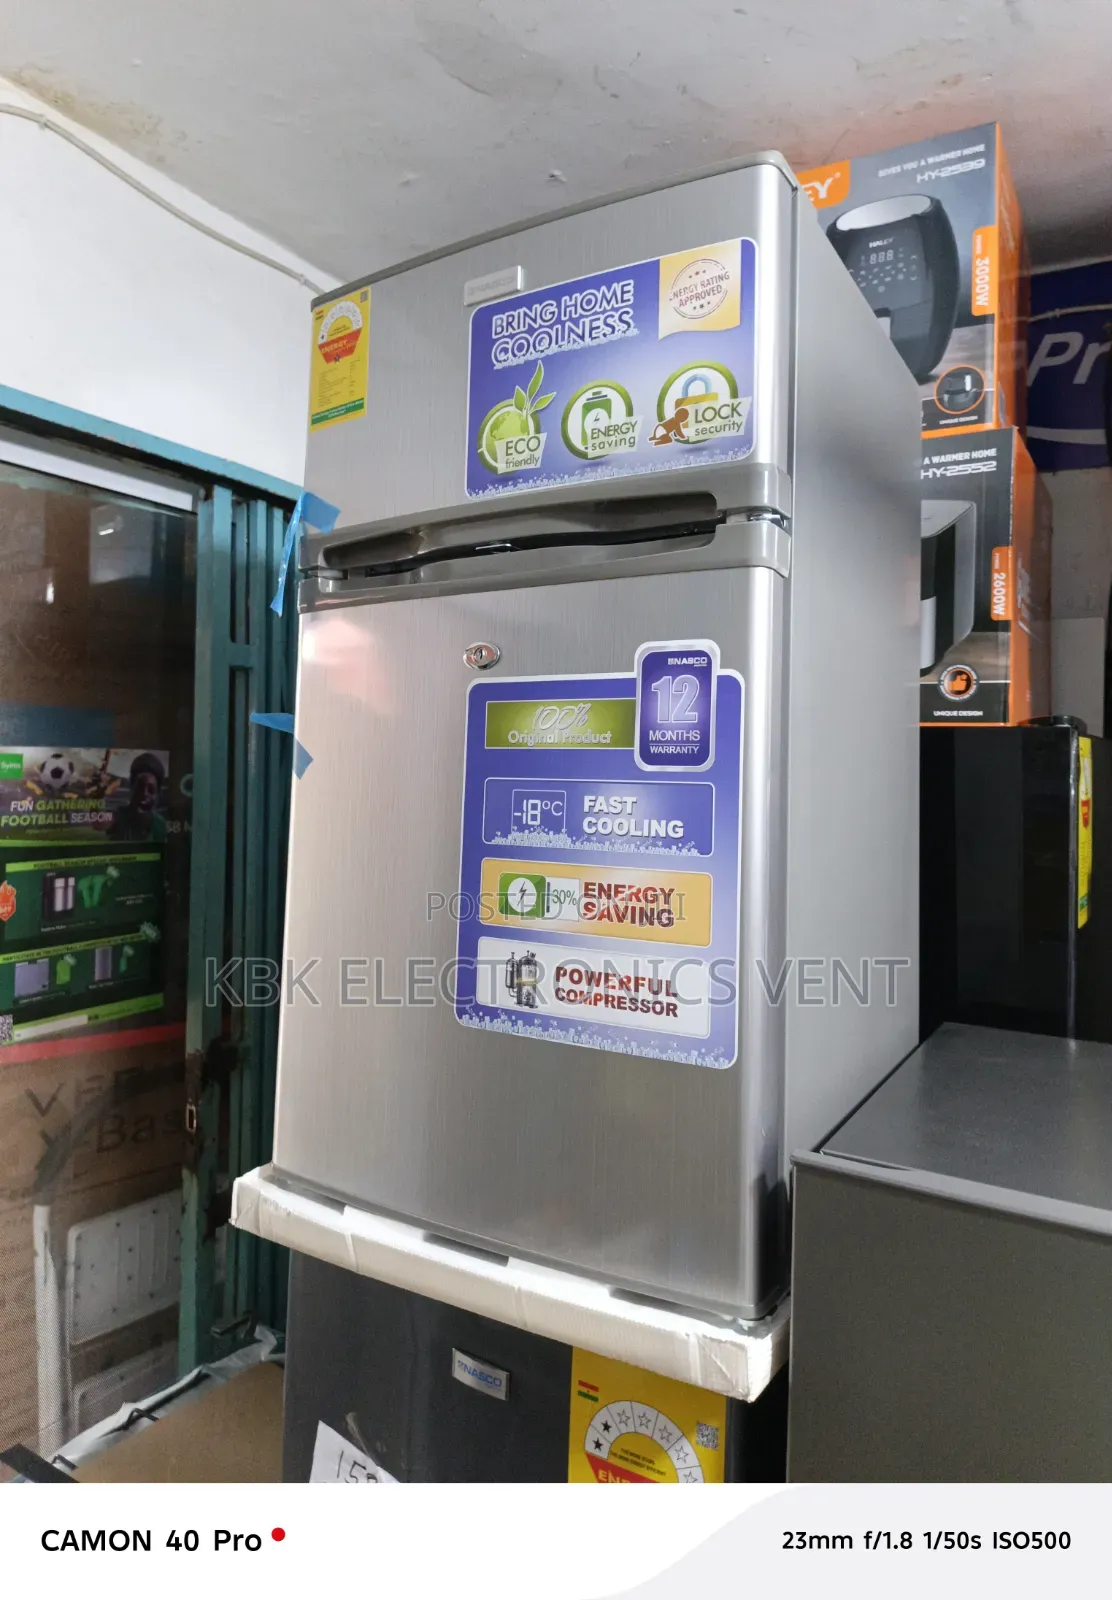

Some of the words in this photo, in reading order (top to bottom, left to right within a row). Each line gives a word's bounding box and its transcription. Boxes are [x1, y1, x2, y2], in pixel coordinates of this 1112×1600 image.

[962, 144, 985, 156] HOME
[700, 271, 730, 289] RATING
[975, 257, 990, 306] 3000W
[679, 285, 723, 308] APPROVED
[492, 301, 558, 338] BRING
[561, 280, 634, 320] HOME
[491, 308, 634, 364] COOLNESS
[694, 401, 743, 424] LOCK
[590, 421, 638, 440] ENERGY
[695, 420, 743, 436] security
[505, 436, 541, 456] ECO
[591, 436, 636, 451] saving
[505, 454, 541, 469] friendly
[923, 456, 930, 465] A
[931, 452, 970, 464] WARMER
[971, 448, 997, 459] HOME
[920, 461, 997, 479] HY-2552
[993, 572, 1006, 616] 2600W
[651, 675, 700, 723] 12
[533, 703, 592, 731] 100%
[508, 730, 558, 748] Original
[563, 731, 612, 745] Product
[649, 730, 700, 742] MONTHS
[650, 745, 699, 755] WARRANTY
[10, 801, 34, 812] FUN
[36, 799, 106, 811] GATHERING
[583, 796, 637, 816] FAST
[1, 814, 68, 828] FOOTBALL
[71, 812, 113, 823] SEASON
[582, 817, 684, 839] COOLING
[552, 888, 578, 906] 30%
[583, 881, 675, 906] ENERGY
[582, 901, 674, 928] SAVING
[555, 966, 678, 998] POWERFUL
[555, 987, 678, 1018] COMPRESSOR
